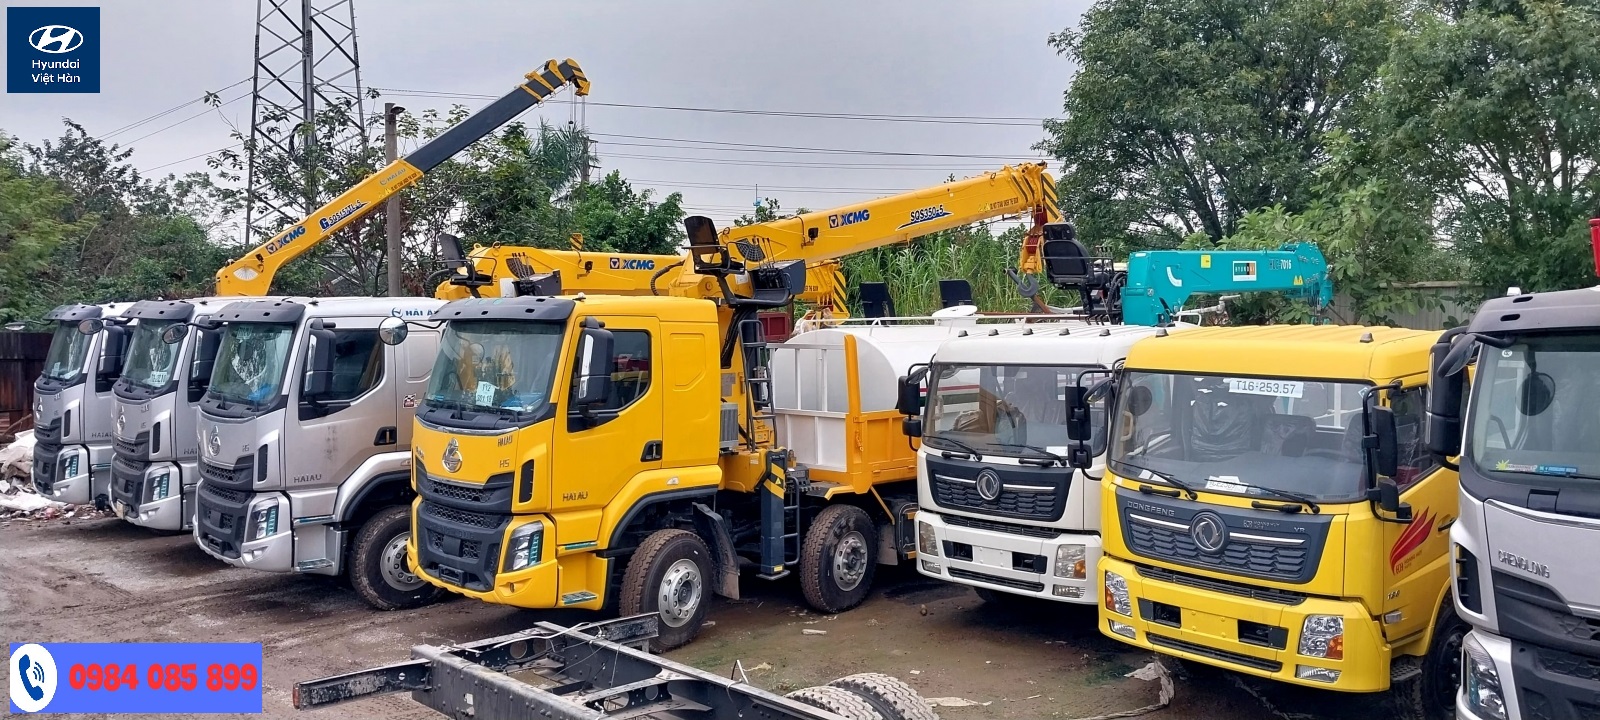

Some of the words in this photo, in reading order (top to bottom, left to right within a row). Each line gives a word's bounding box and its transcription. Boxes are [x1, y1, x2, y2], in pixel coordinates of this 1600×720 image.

[840, 209, 870, 227] XCMG
[910, 204, 945, 222] SQS350-5
[277, 225, 306, 249] XCMG
[620, 259, 655, 270] XCMG
[1236, 380, 1296, 395] T16-253.57
[293, 473, 322, 484] HAIAU
[1127, 500, 1176, 517] DONGFENG
[1497, 548, 1551, 579] CHENGLONG
